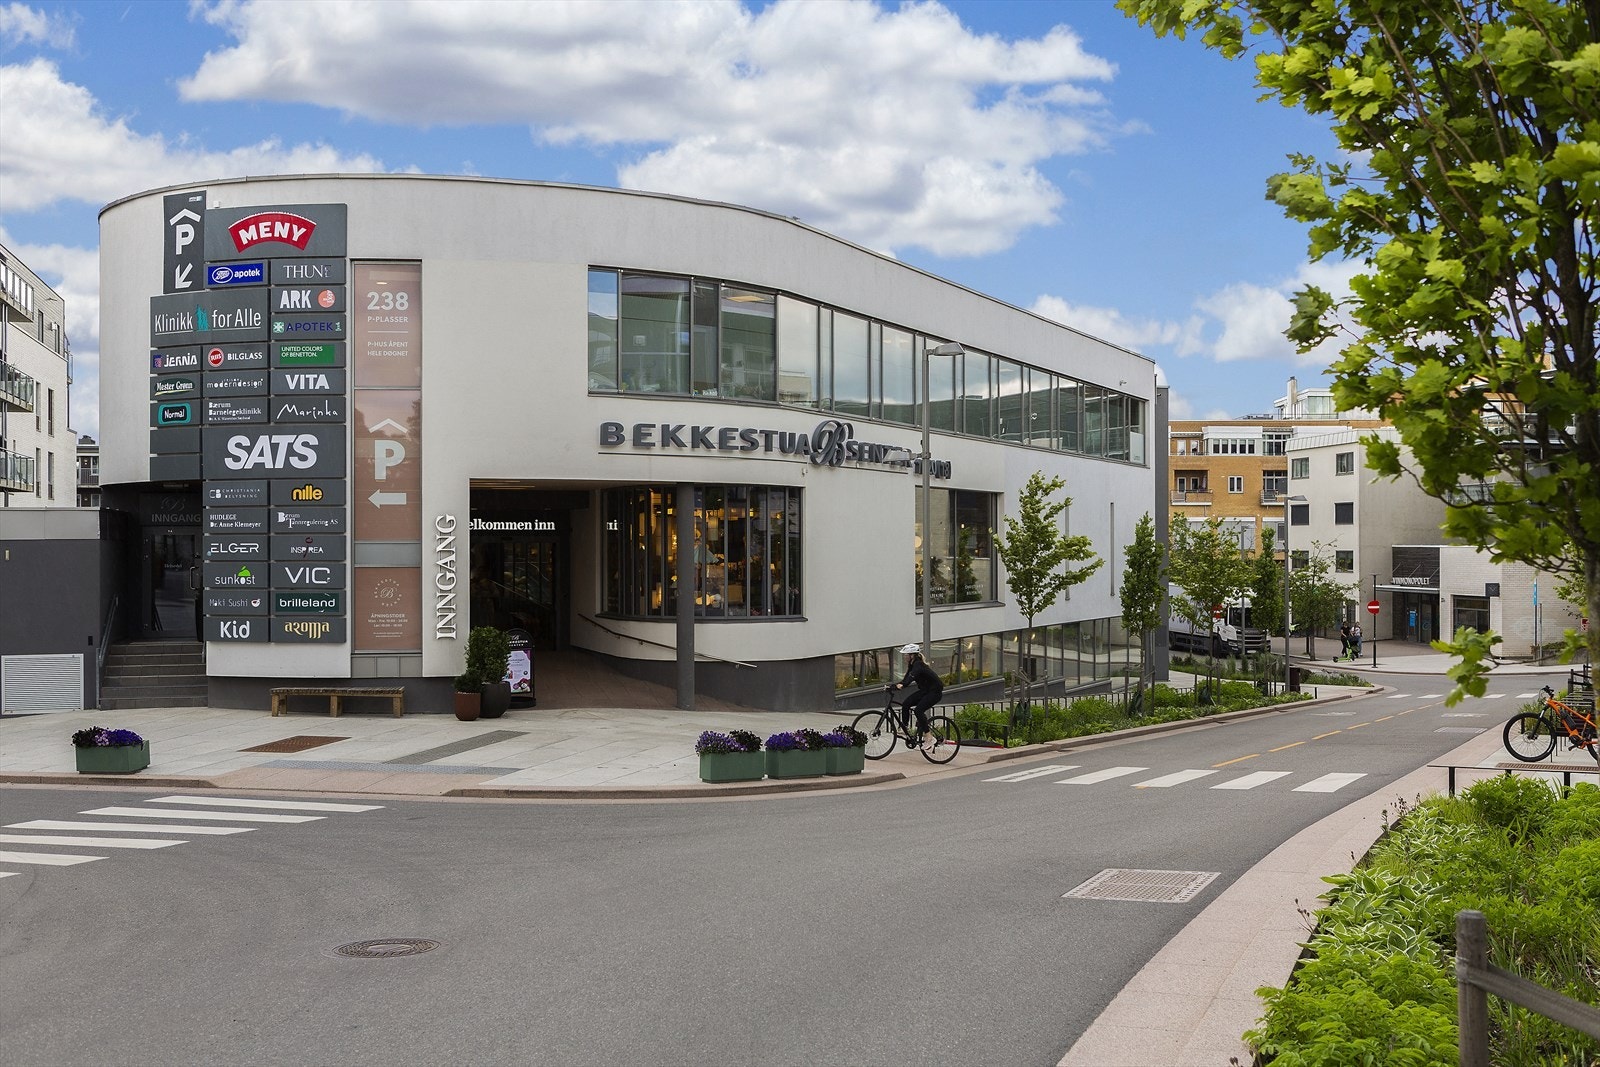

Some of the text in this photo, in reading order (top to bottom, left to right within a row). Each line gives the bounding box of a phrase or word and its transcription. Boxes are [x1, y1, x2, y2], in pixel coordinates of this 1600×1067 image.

[239, 221, 306, 245] MENY
[234, 268, 260, 279] apotek
[280, 290, 311, 308] ARK
[367, 291, 409, 311] 238
[155, 308, 261, 332] Klinikk for Alle
[286, 322, 333, 331] APOTEK
[388, 340, 408, 348] ÅPENT
[227, 352, 263, 361] BILGLASS
[206, 379, 263, 389] moderndesign
[285, 374, 330, 390] VITA
[164, 408, 185, 419] Normal
[208, 408, 262, 416] Barnelegeklinikk
[276, 400, 338, 420] Marinka
[600, 421, 811, 456] BEKKESTUA
[224, 434, 319, 470] SATS
[375, 440, 405, 480] P
[292, 485, 323, 501] nille
[151, 513, 201, 522] INNGANG
[468, 519, 555, 531] elkommen inn
[210, 543, 259, 553] ELGER
[215, 574, 256, 585] sunkost
[285, 567, 331, 584] VIC
[435, 513, 457, 640] INNGANG
[1391, 577, 1430, 585] VINMONOPOLET
[209, 598, 248, 607] Maki Sushi
[280, 598, 336, 607] brilleland
[220, 620, 250, 639] Kid
[284, 621, 330, 639] aroma
